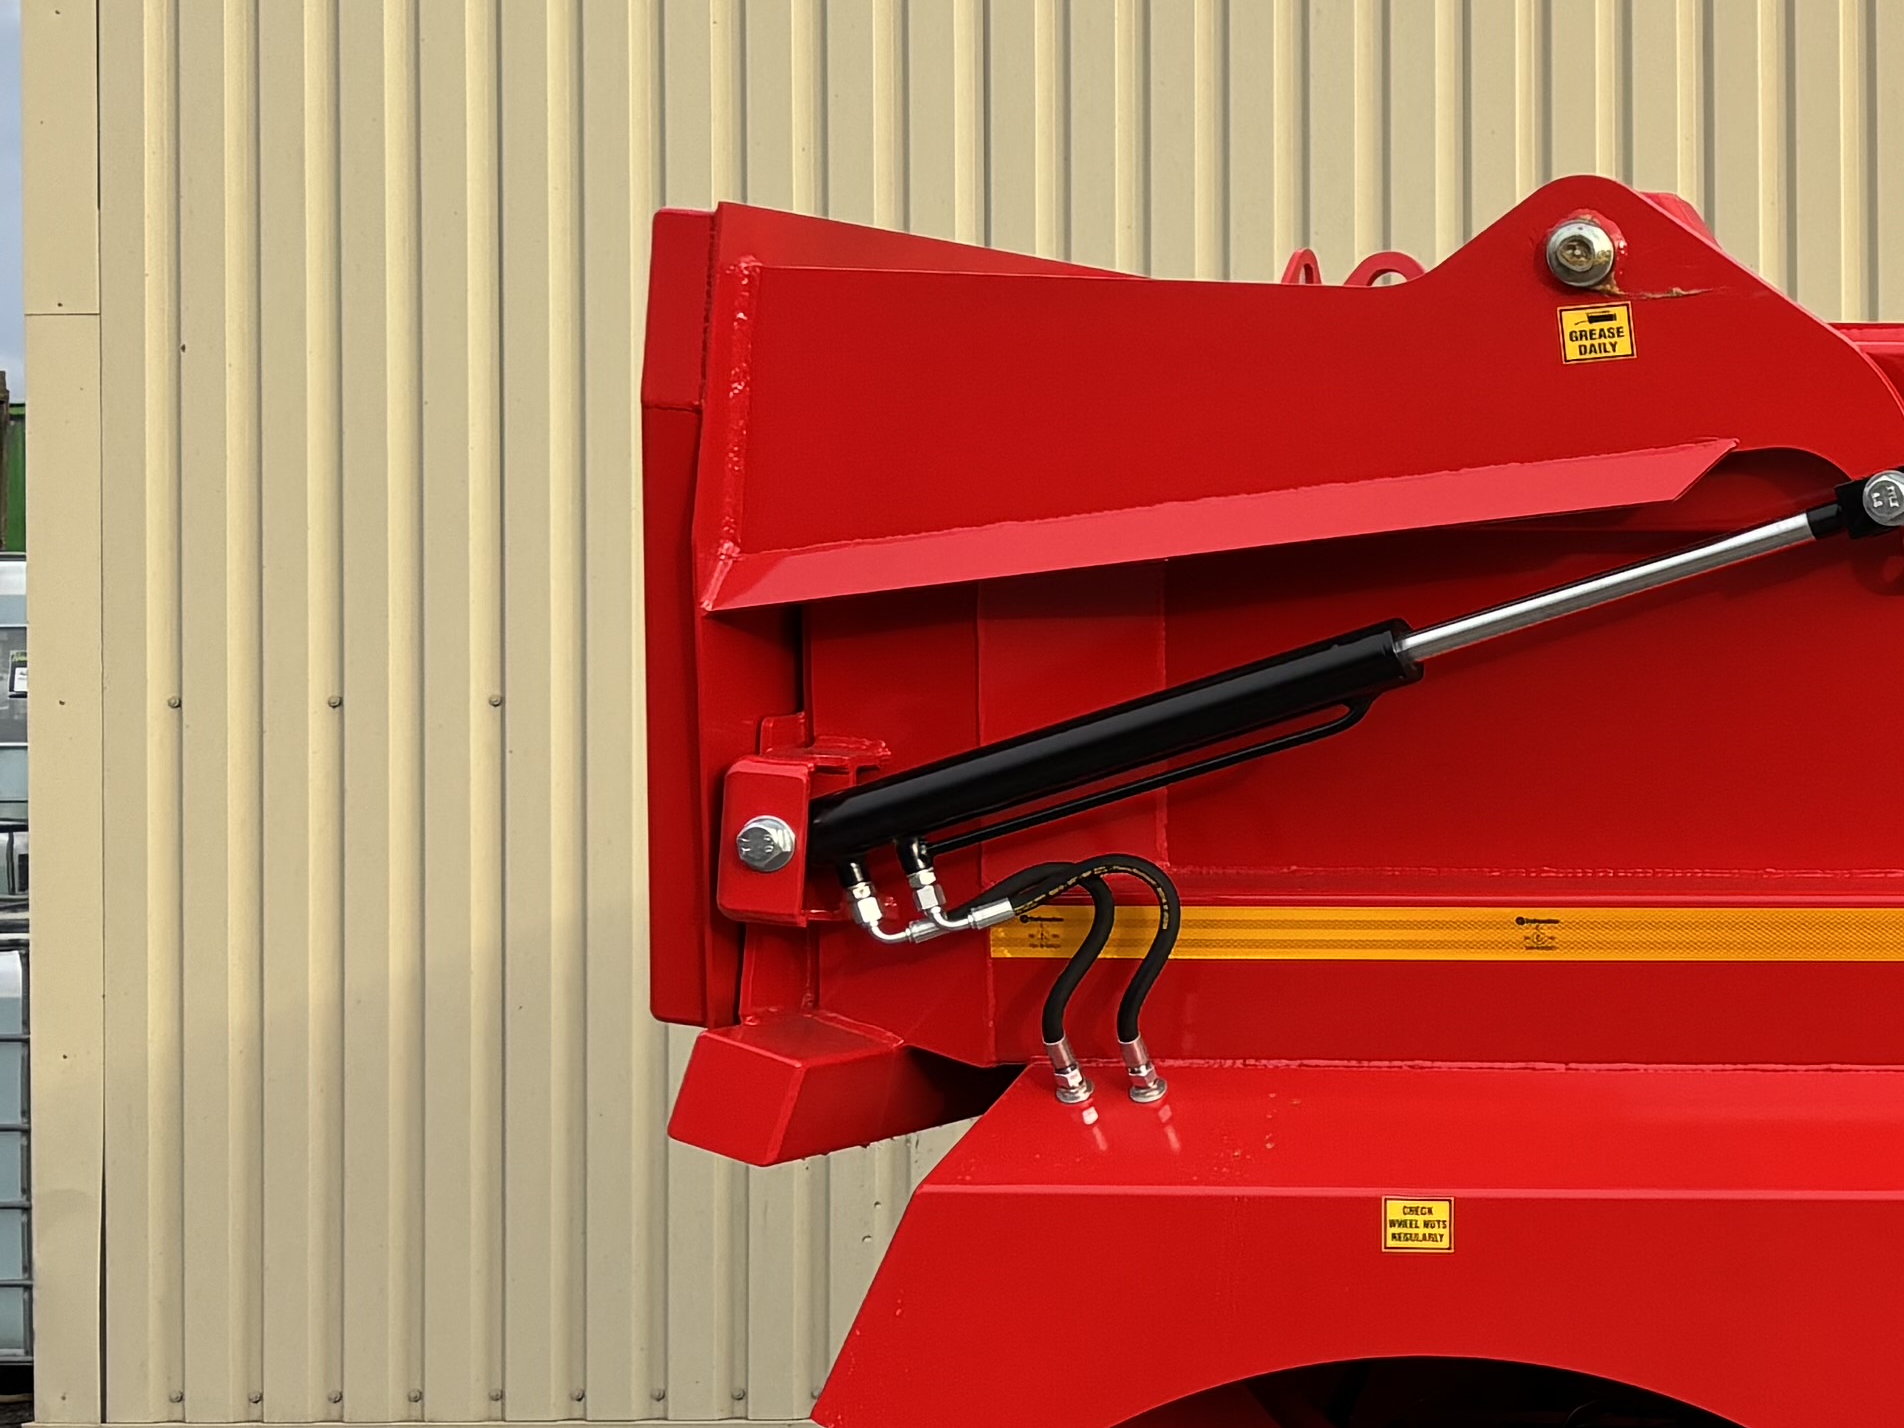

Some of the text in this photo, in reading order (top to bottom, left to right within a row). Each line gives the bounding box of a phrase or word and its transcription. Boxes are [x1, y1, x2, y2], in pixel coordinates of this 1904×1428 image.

[1569, 326, 1625, 342] GREASE
[1578, 341, 1618, 356] DAILY
[1423, 1219, 1448, 1229] NUTS
